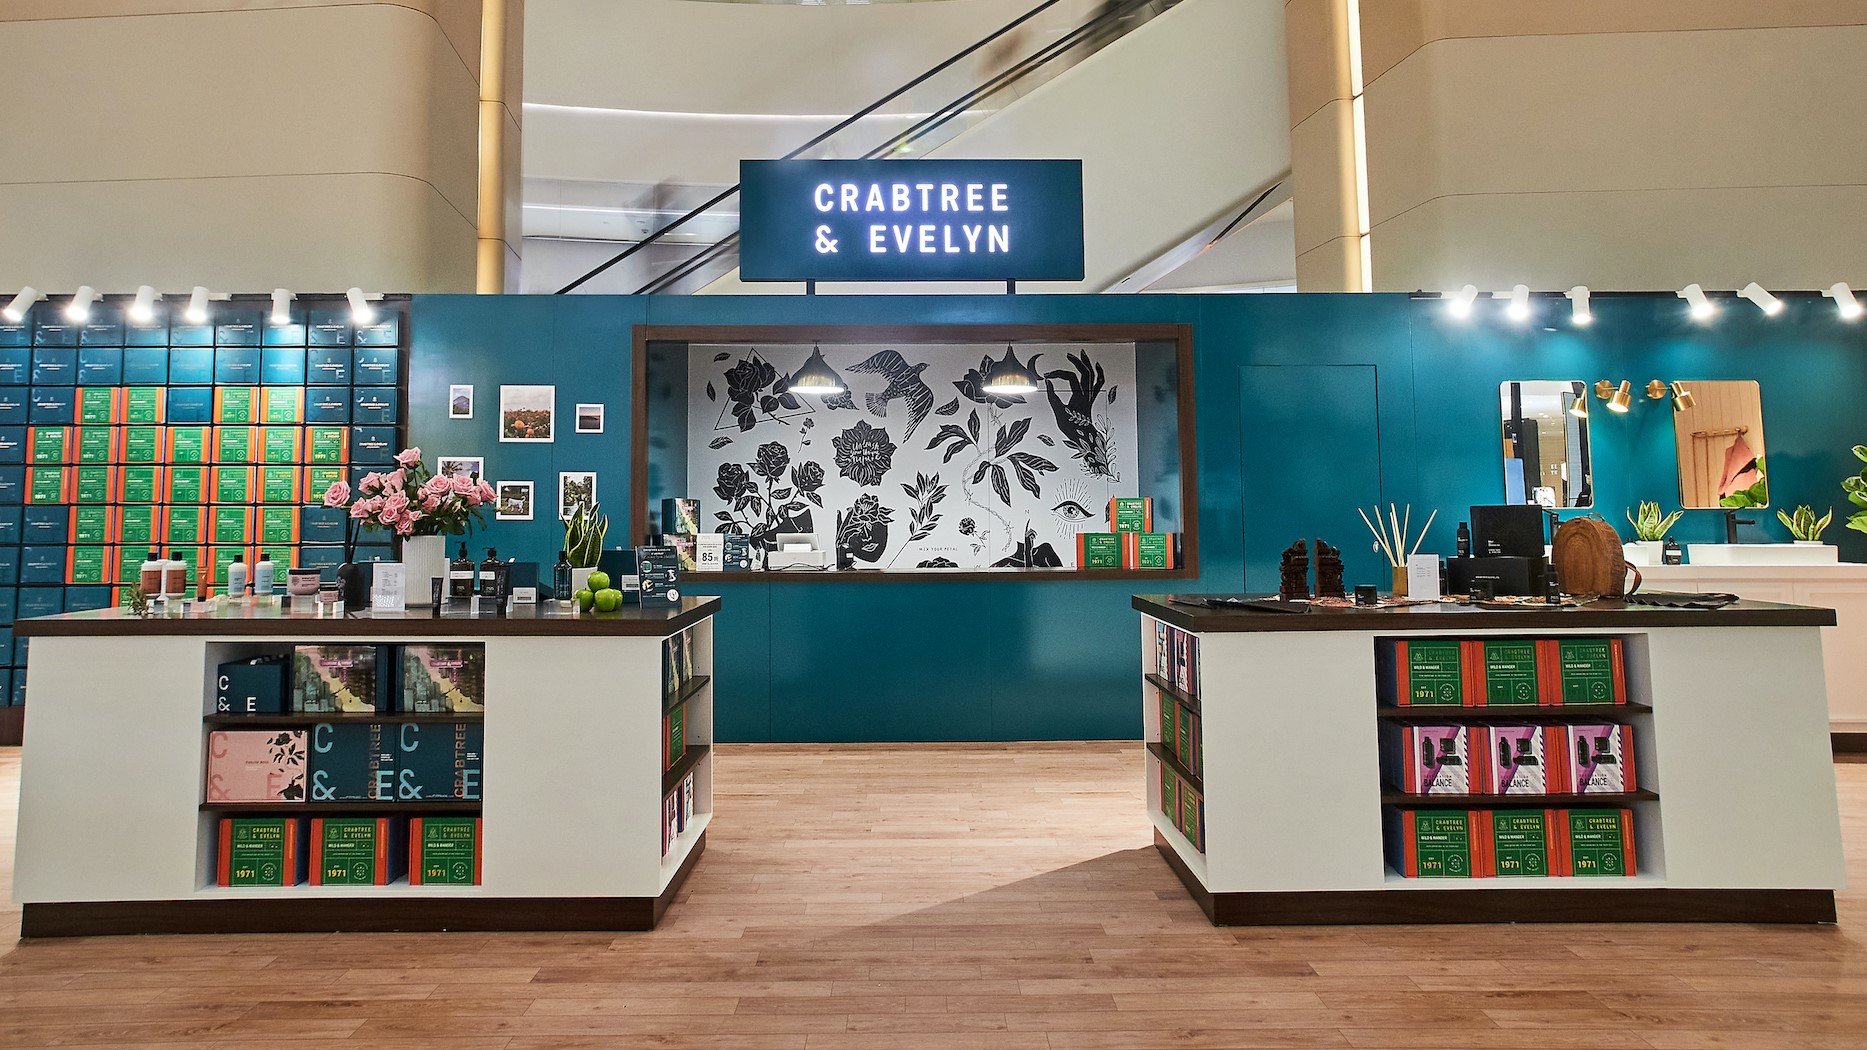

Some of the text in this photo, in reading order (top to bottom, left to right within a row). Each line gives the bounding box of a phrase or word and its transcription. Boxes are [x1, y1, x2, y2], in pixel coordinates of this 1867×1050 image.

[814, 183, 1009, 213] CRABTREE
[814, 225, 1009, 254] & EVELYN
[702, 552, 713, 562] 85
[218, 675, 229, 691] C
[1415, 690, 1434, 698] 1971
[218, 696, 257, 712] & E
[314, 723, 334, 753] C
[400, 723, 420, 752] C
[312, 770, 395, 800] & E
[398, 768, 481, 800] & E
[1424, 778, 1452, 787] BALANCE
[1501, 779, 1529, 788] BALANCE
[1580, 777, 1607, 786] BALANCE
[1422, 861, 1442, 869] 1971
[1577, 860, 1596, 868] 1971
[236, 870, 255, 878] 1971
[327, 869, 347, 877] 1971
[427, 869, 446, 877] 1971
